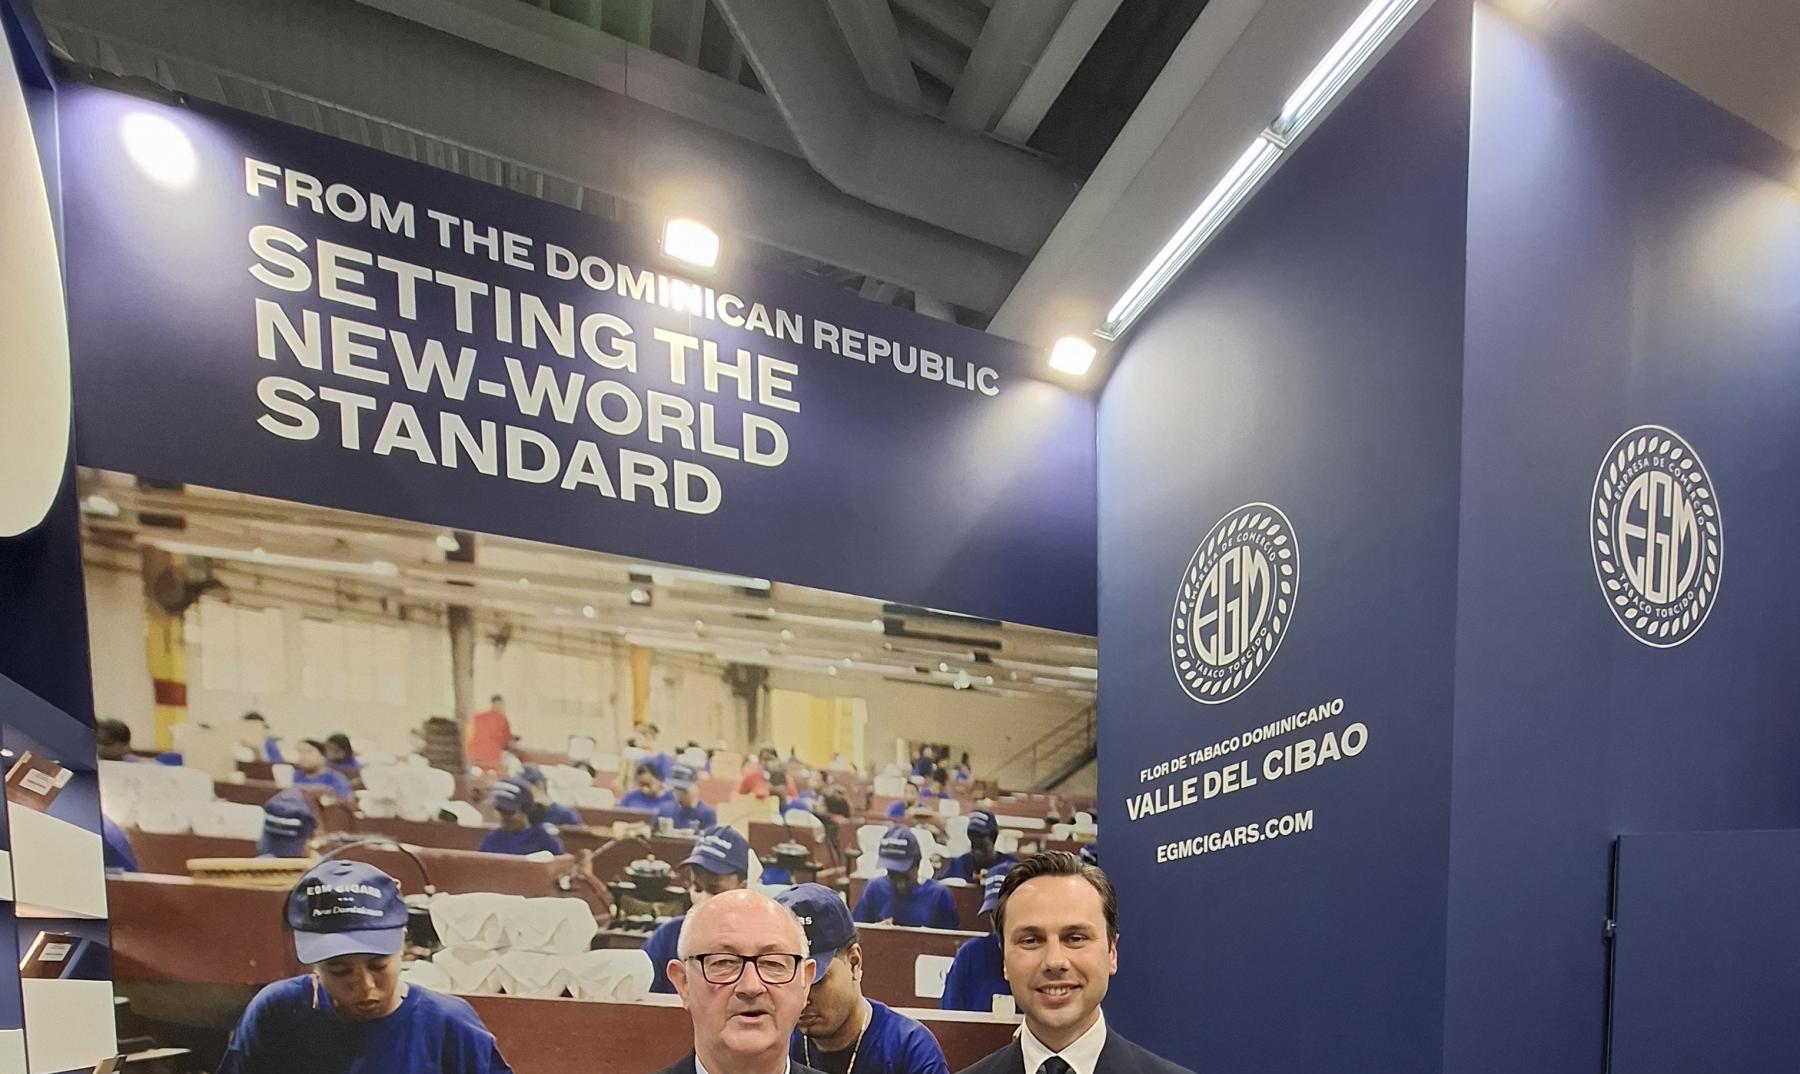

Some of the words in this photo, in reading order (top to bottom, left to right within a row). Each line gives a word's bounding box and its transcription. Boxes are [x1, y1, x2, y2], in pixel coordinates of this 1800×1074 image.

[245, 157, 415, 238] FROM
[427, 209, 536, 271] THE
[547, 244, 802, 345] DOMINICAN
[813, 320, 1000, 396] REPUBLIC
[247, 225, 638, 374] SETTING
[654, 327, 801, 413] THE
[255, 298, 789, 468] NEW-WORLD
[256, 376, 723, 515] STANDARD
[1614, 457, 1650, 501] EMPRESA
[1653, 456, 1665, 468] DE
[1668, 463, 1705, 526] COMERCIO
[1189, 553, 1219, 608] EMPRESA
[1222, 539, 1233, 552] DE
[1237, 532, 1276, 562] COMERCIO
[1619, 470, 1699, 605] EGM
[1193, 546, 1271, 667] EGM
[1619, 573, 1652, 615] TABACO
[1655, 590, 1695, 619] TORCIDO
[1195, 660, 1225, 678] TABACO
[1228, 627, 1268, 675] TORCIDO
[1126, 777, 1198, 821] VALLE
[1203, 760, 1257, 799] DEL
[1263, 722, 1369, 781] CIBAO
[1140, 762, 1170, 783] FLOR
[1171, 755, 1187, 773] DE
[1189, 736, 1240, 766] TABACO
[1242, 698, 1344, 747] DOMINICANO
[1156, 810, 1314, 864] EGMCIGARS.COM
